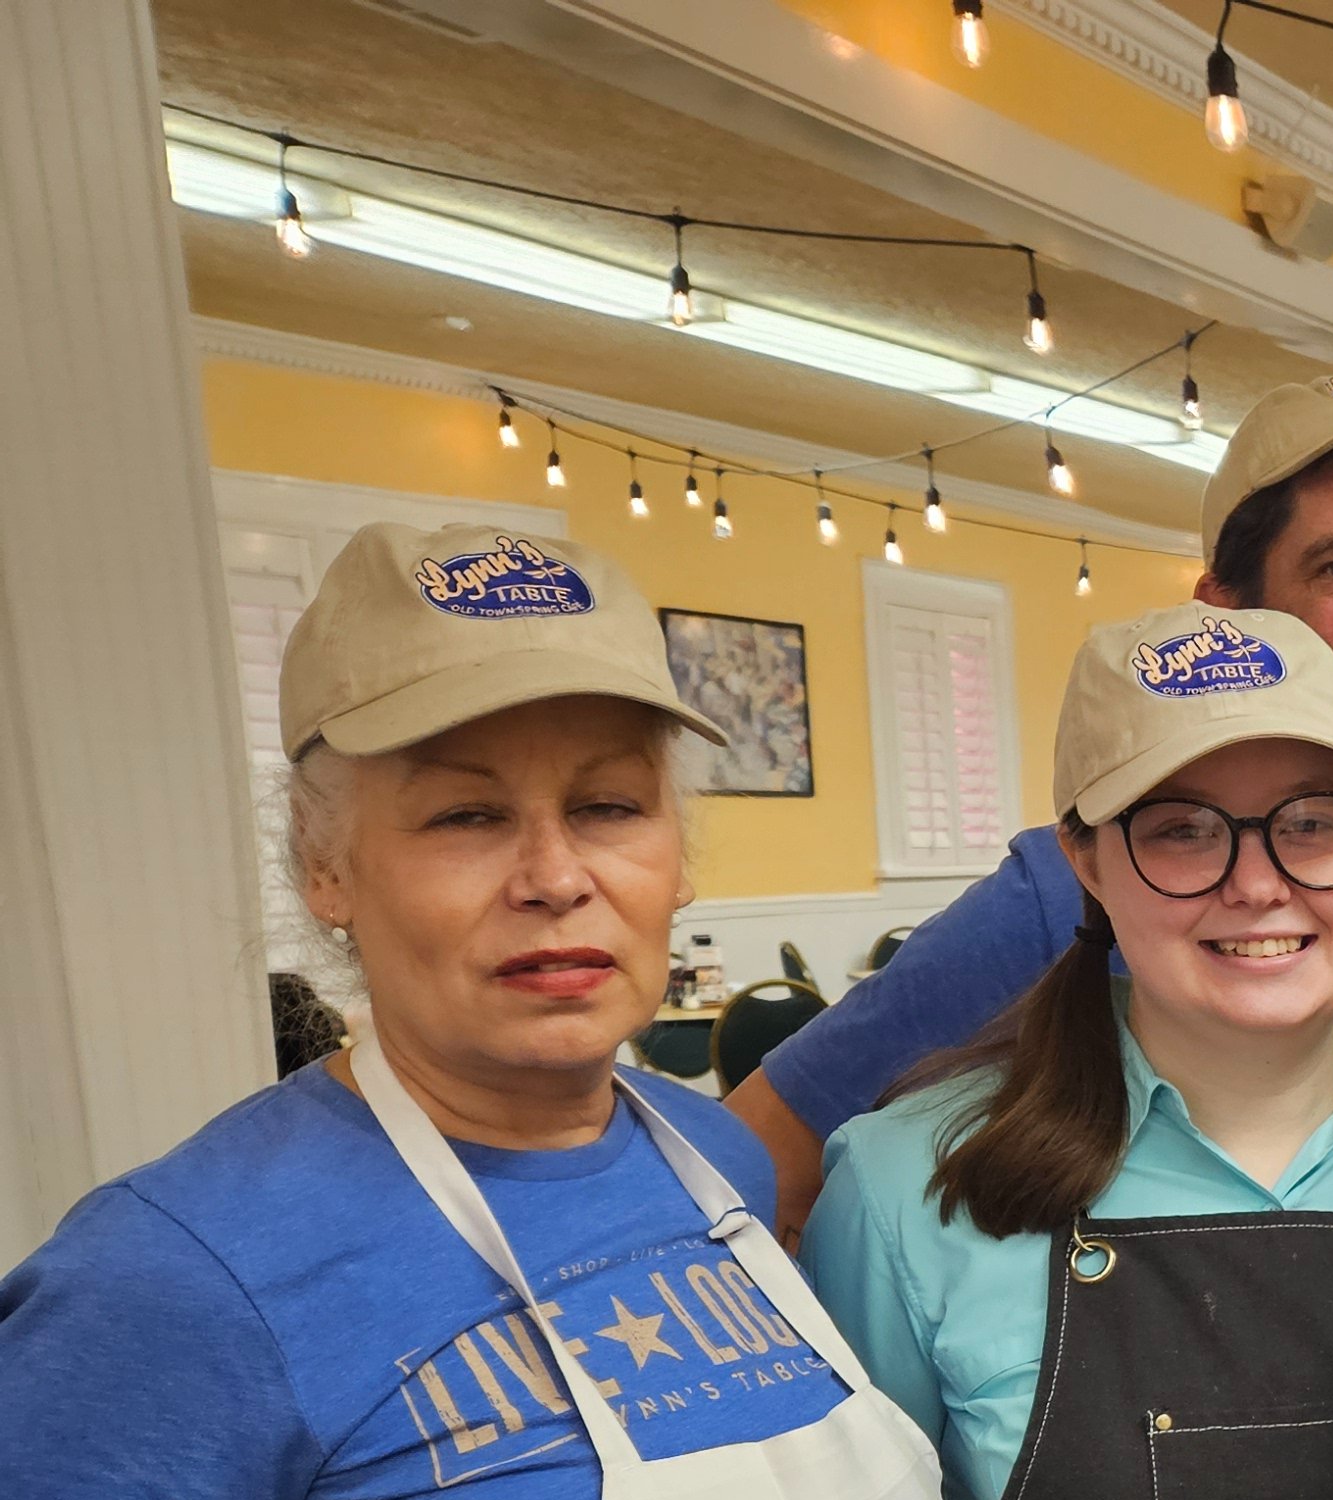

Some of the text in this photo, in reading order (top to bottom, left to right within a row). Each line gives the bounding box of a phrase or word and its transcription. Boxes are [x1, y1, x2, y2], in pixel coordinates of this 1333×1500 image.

[415, 536, 545, 601] Lynn's
[495, 587, 571, 604] TABLE
[450, 604, 475, 614] OLD
[479, 607, 514, 616] TOWN
[1132, 616, 1244, 684] Lynn's
[1200, 665, 1262, 681] TABLE
[1163, 687, 1182, 695] OLD
[1186, 685, 1215, 695] TOWN
[559, 1257, 609, 1281] SHOP
[648, 1261, 800, 1366] LOC
[615, 1381, 721, 1429] YNN'S
